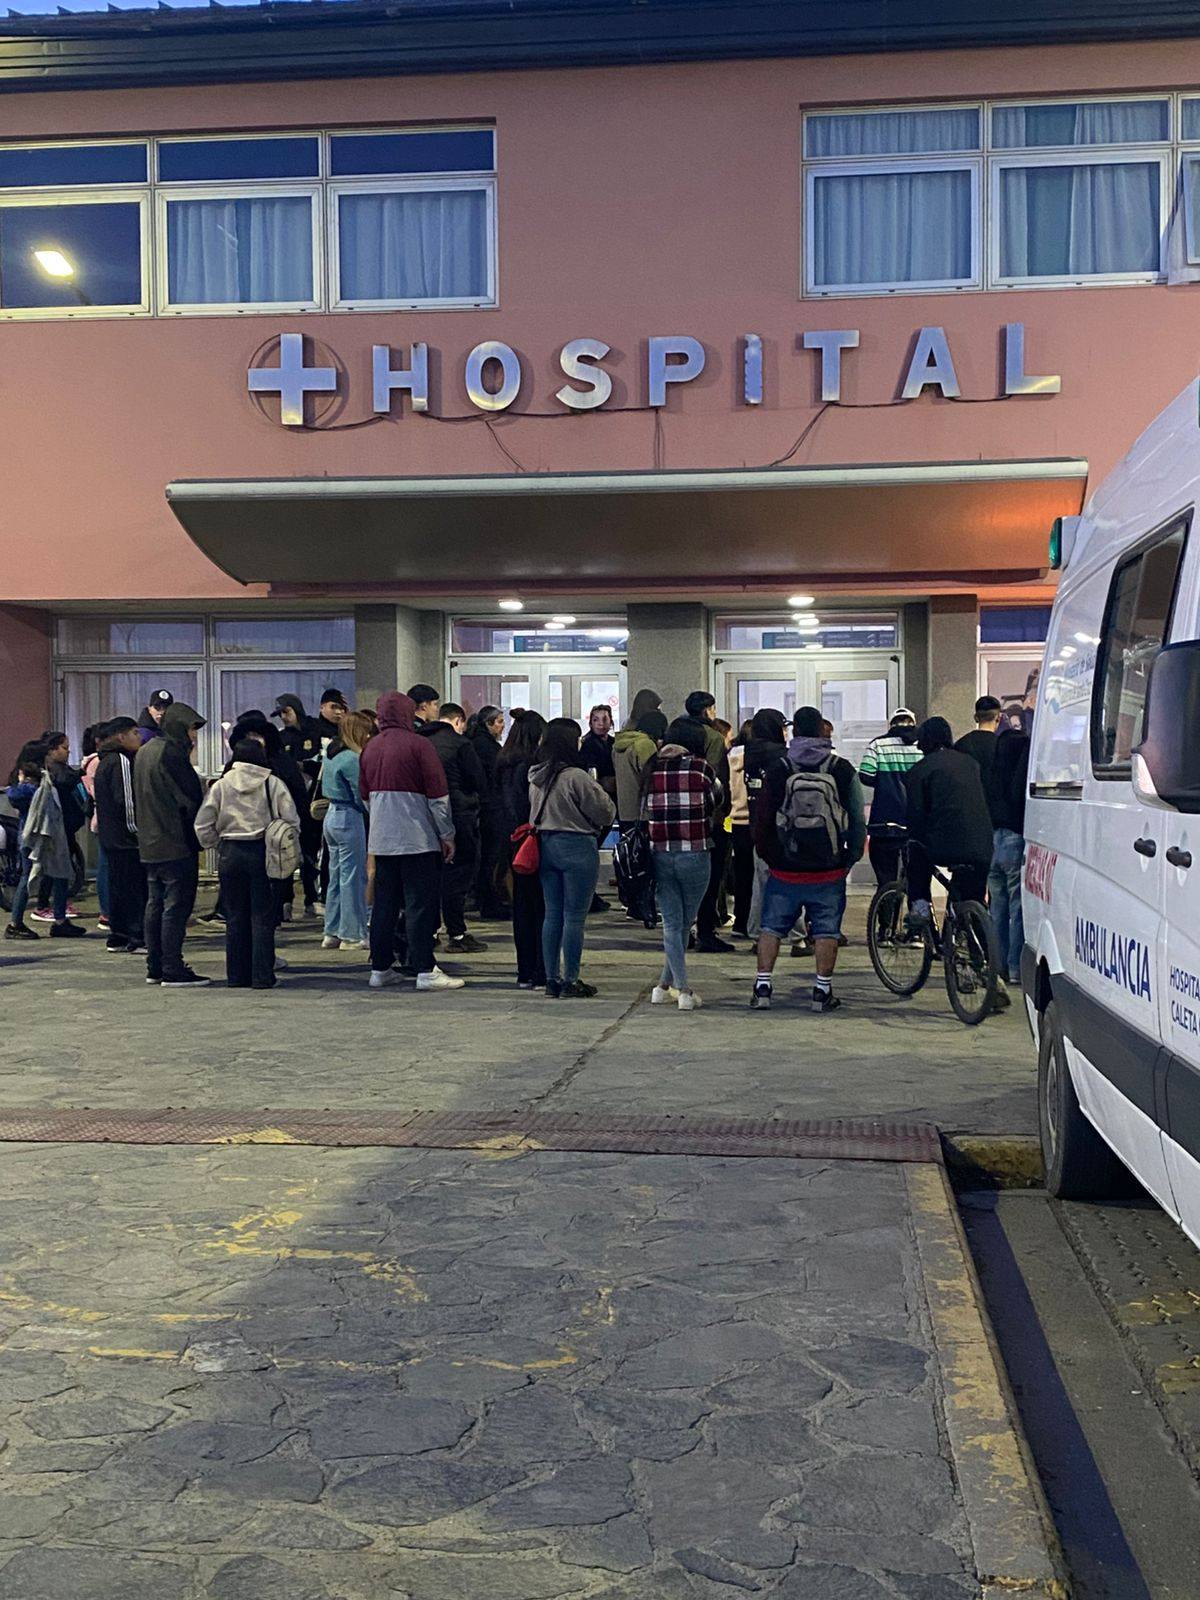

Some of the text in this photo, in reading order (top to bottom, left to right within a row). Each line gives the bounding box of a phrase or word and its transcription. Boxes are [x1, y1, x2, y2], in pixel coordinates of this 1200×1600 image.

[373, 322, 1061, 413] HOSPITAL
[1075, 915, 1151, 1002] AMBULANCIA
[1171, 1000, 1198, 1035] CALETA
